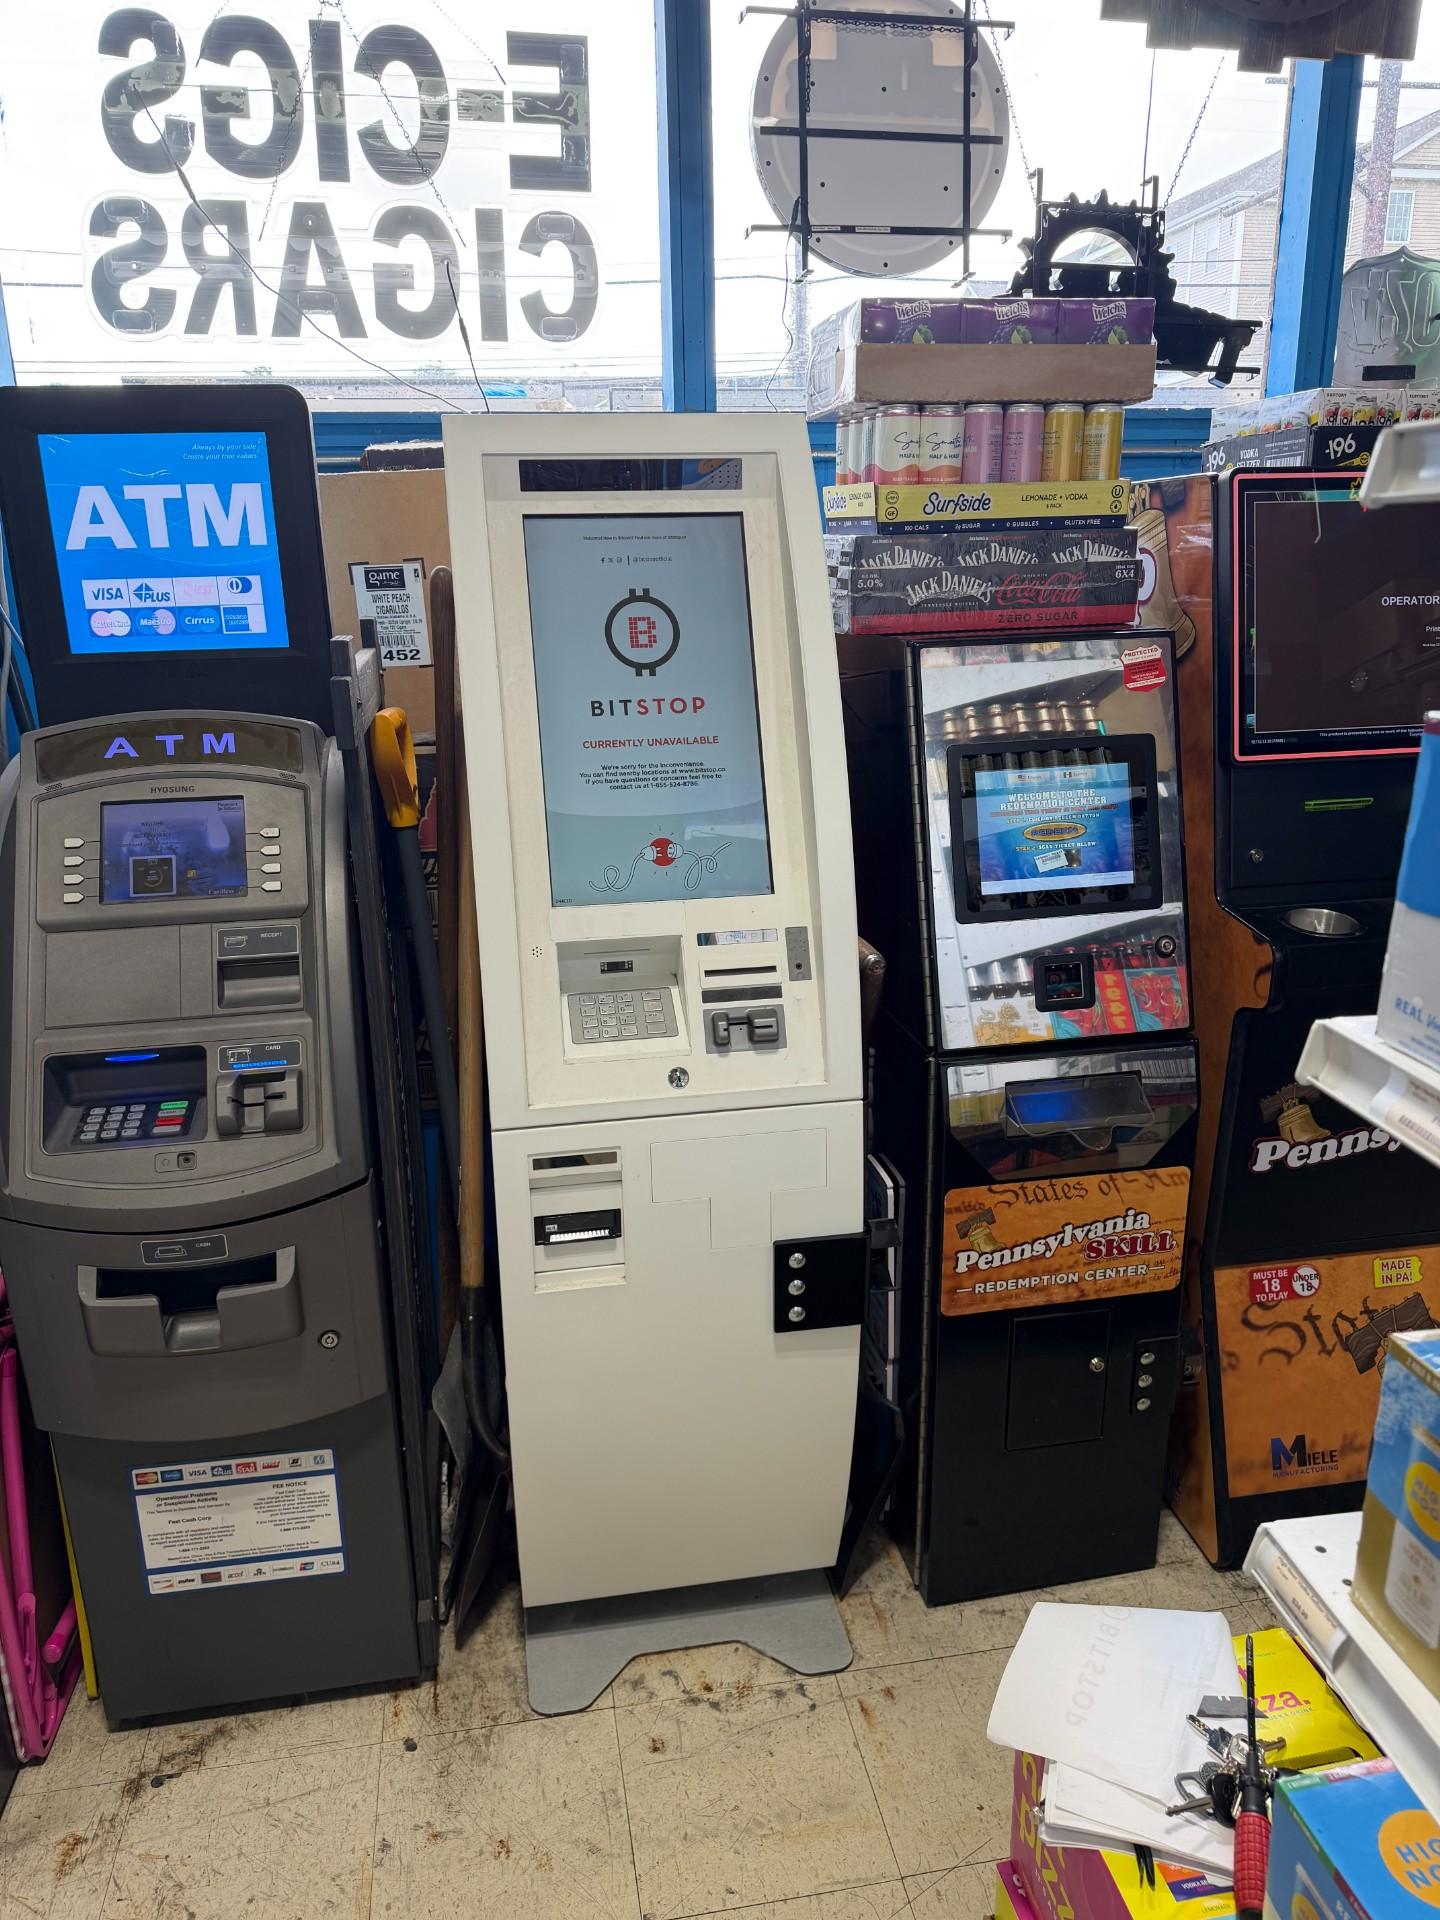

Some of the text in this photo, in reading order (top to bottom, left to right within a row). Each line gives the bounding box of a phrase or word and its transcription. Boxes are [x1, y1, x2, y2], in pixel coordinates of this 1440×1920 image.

[897, 300, 931, 320] Welch's
[995, 300, 1030, 320] Welch's
[191, 443, 216, 451] Always
[226, 443, 242, 451] your
[242, 442, 257, 450] side
[1325, 433, 1356, 460] -196
[183, 452, 257, 461] Create your true values
[923, 491, 992, 515] Surfside
[1020, 493, 1088, 502] LEMONADE VODKA
[65, 482, 268, 550] ATM
[368, 570, 400, 588] game
[857, 578, 884, 588] 5.0%
[92, 587, 171, 603] VISA PLUS
[905, 570, 992, 607] JACK DANIEL'S
[371, 593, 411, 604] WHITE PEACH
[1381, 595, 1440, 606] OPERATOR
[375, 604, 410, 615] CIGARILLOS
[140, 617, 172, 627] Maestro
[184, 616, 216, 625] Cirrus
[998, 611, 1078, 624] ZERO SUGAR
[383, 649, 421, 661] 452
[1124, 647, 1159, 658] PROTECTED
[590, 696, 706, 717] BITSTOP
[104, 732, 237, 758] ATM
[582, 735, 720, 750] CURRENTLY UNAVAILABLE
[591, 778, 604, 786] you
[620, 776, 651, 784] questions
[609, 783, 633, 791] contact
[150, 785, 195, 794] HYOSUNG
[1007, 788, 1096, 802] WELCOME TO THE
[1000, 797, 1067, 811] REDEMPTION
[1068, 796, 1107, 807] CENTER
[955, 1207, 1151, 1274] Pennsylvania
[1084, 1230, 1177, 1261] SKILL
[1381, 1259, 1412, 1271] MADE
[975, 1264, 1148, 1294] REDEMPTION CENTER
[1253, 1269, 1289, 1281] MUST BE
[1293, 1273, 1320, 1283] UNDER
[1381, 1271, 1413, 1285] IN PA!
[1262, 1278, 1281, 1293] 18
[1300, 1281, 1313, 1292] 18
[1255, 1291, 1289, 1302] TO PLAY
[1270, 1434, 1339, 1471] MIELE
[188, 1468, 207, 1477] VISA
[1272, 1464, 1339, 1478] MANUFACTURING
[285, 1480, 308, 1488] NOTICE
[155, 1490, 218, 1503] Operational Problems
[163, 1498, 195, 1508] Suspicious
[196, 1496, 218, 1505] Activity
